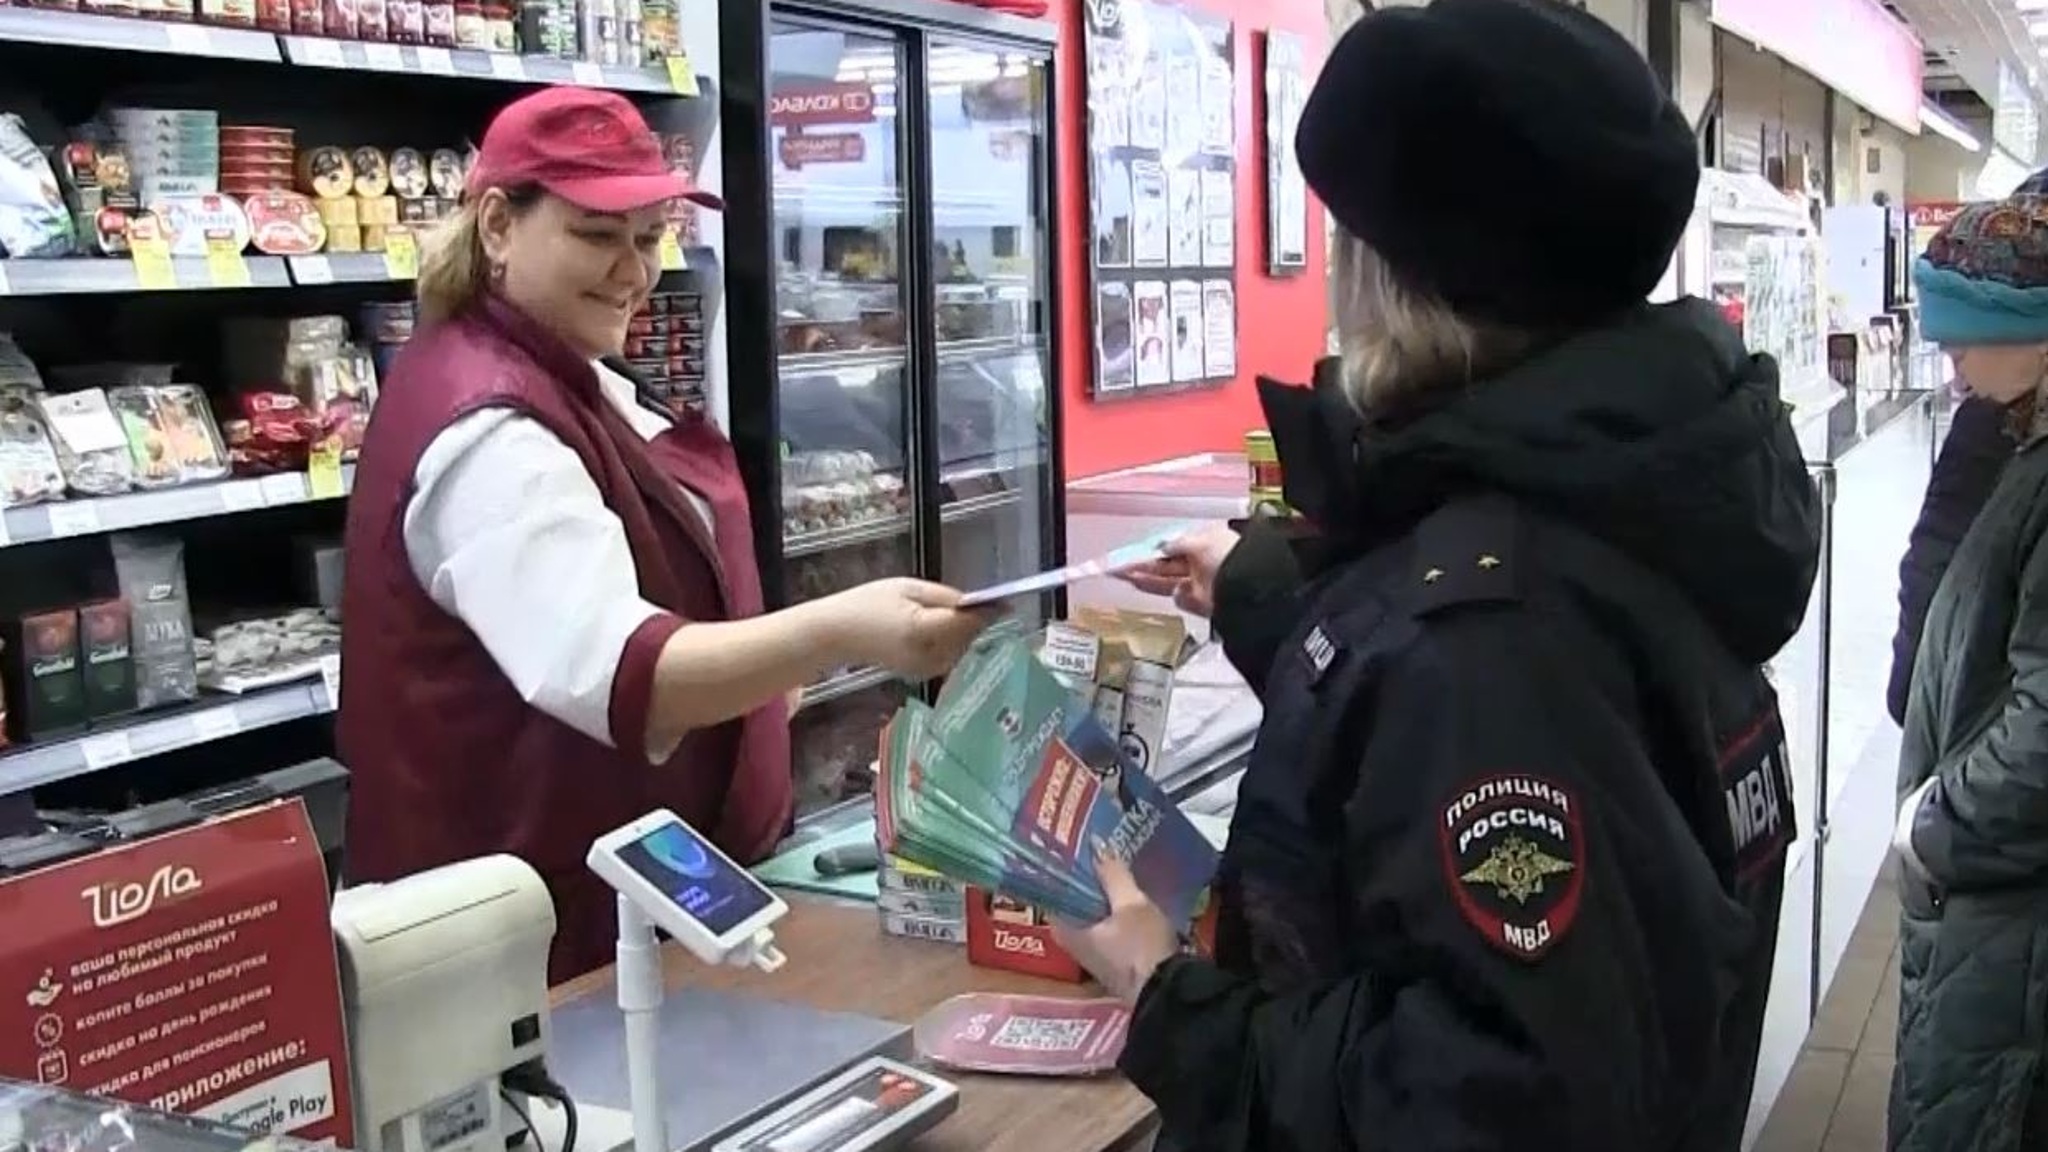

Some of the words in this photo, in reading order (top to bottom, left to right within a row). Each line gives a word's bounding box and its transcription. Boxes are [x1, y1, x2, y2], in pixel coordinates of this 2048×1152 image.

[1446, 778, 1569, 827] ПОЛИЦИЯ
[1458, 808, 1565, 854] РОССИЯ
[1726, 754, 1780, 853] МВД
[70, 953, 115, 977] ваша
[118, 915, 226, 965] персональная
[228, 899, 279, 925] скидка
[72, 976, 93, 995] на
[97, 950, 173, 986] любимый
[175, 930, 238, 961] продукт
[1503, 919, 1552, 951] МВД
[76, 1002, 132, 1031] копите
[134, 982, 185, 1009] баллы
[188, 974, 205, 990] за
[207, 954, 268, 985] покупки
[79, 1033, 136, 1067] скидка
[138, 1027, 158, 1043] на
[161, 1013, 197, 1037] день
[199, 985, 272, 1024] рождения
[142, 1057, 170, 1081] для
[172, 1020, 266, 1064] пенсионеров
[249, 1107, 285, 1133] ogle
[289, 1095, 328, 1117] Play
